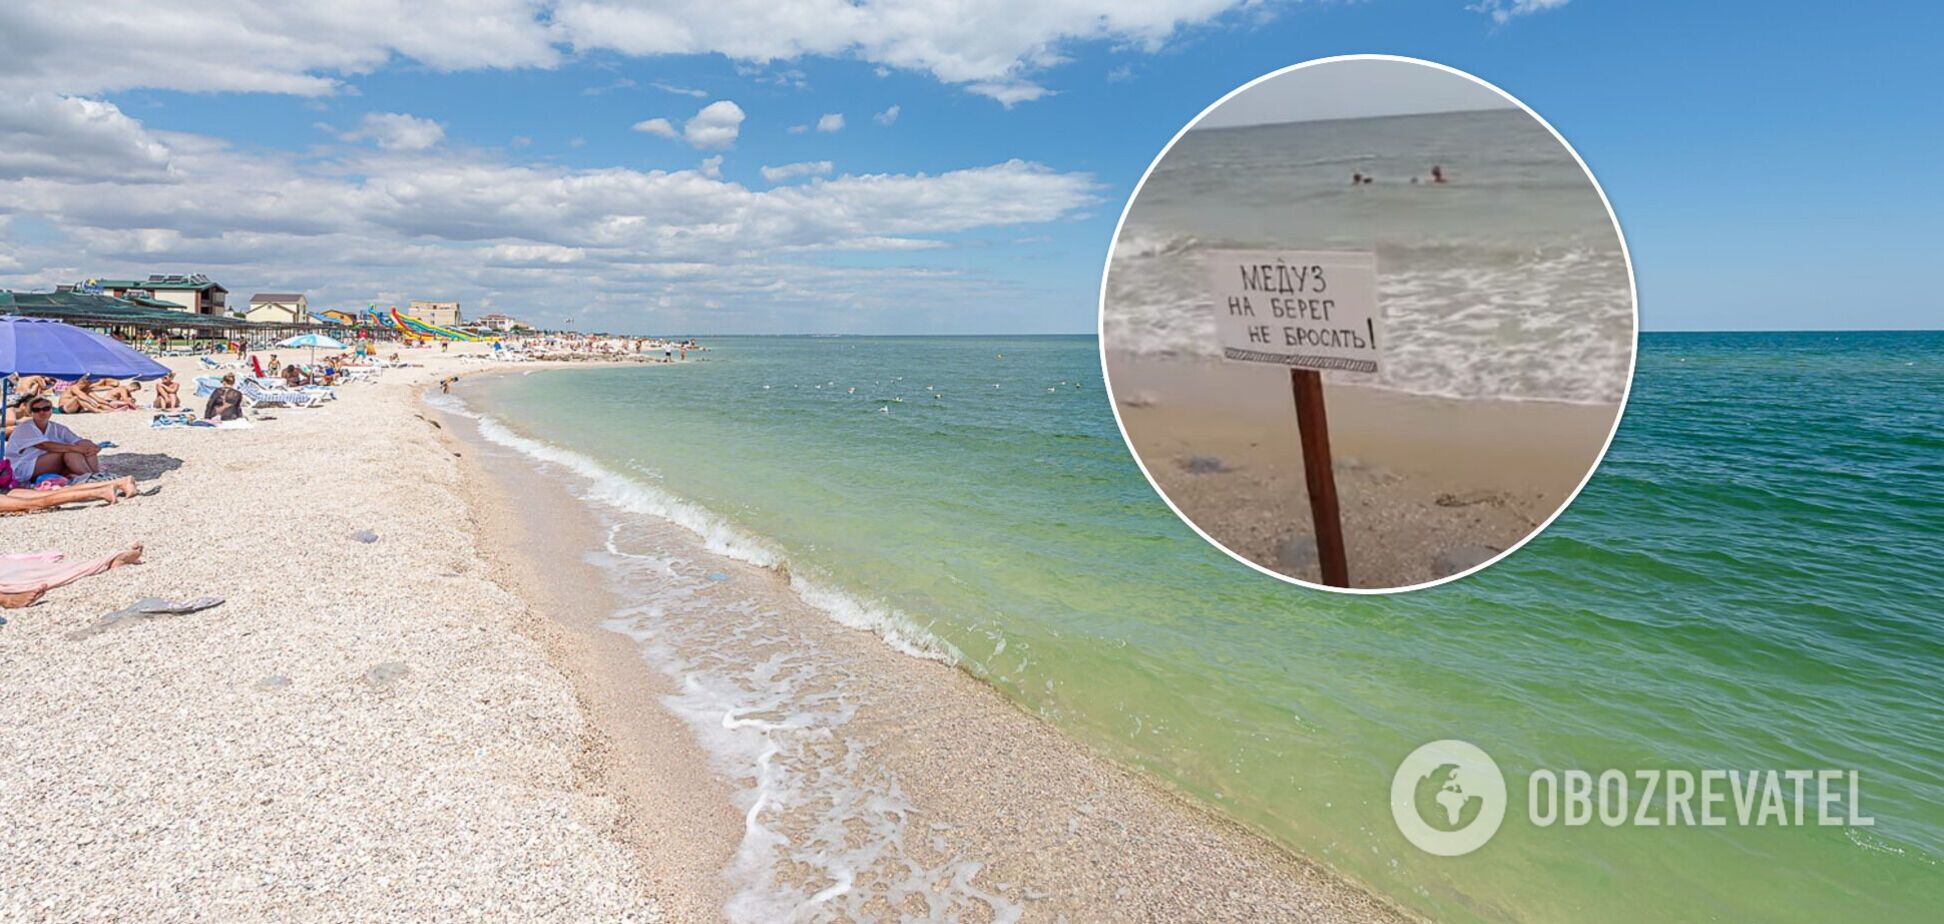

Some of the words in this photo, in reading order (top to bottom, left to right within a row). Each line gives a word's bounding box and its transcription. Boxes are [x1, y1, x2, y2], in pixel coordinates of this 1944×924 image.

[1241, 265, 1327, 294] МЕДУЗ
[1228, 297, 1256, 317] НА
[1271, 298, 1335, 321] БЕРЕГ
[1249, 326, 1271, 344] НЕ
[1284, 318, 1376, 350] БРОСАТЬ!
